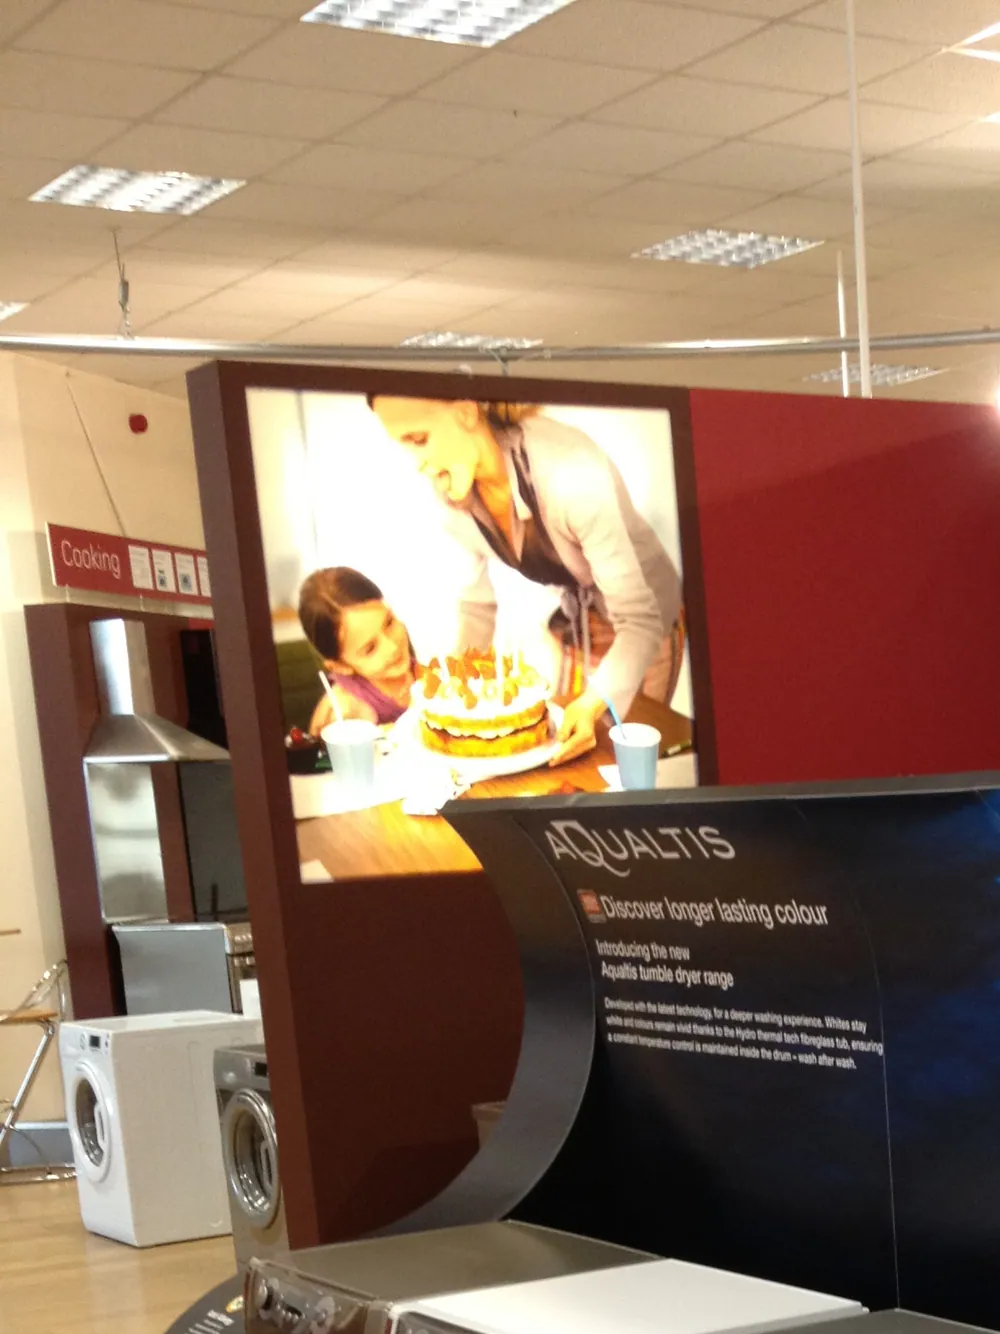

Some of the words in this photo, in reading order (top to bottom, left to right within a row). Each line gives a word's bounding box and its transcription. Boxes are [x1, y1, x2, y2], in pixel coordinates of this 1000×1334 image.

[60, 538, 121, 580] Cooking
[543, 819, 736, 877] AQUALTIS
[600, 895, 665, 920] Discover
[664, 896, 715, 928] longer
[715, 897, 774, 930] lasting
[775, 899, 829, 927] colour
[595, 939, 650, 960] Introducing
[650, 941, 667, 959] the
[668, 945, 689, 960] new
[601, 961, 637, 980] Aqualtis
[638, 964, 673, 982] tumble
[674, 966, 701, 987] dryer
[703, 970, 733, 990] range
